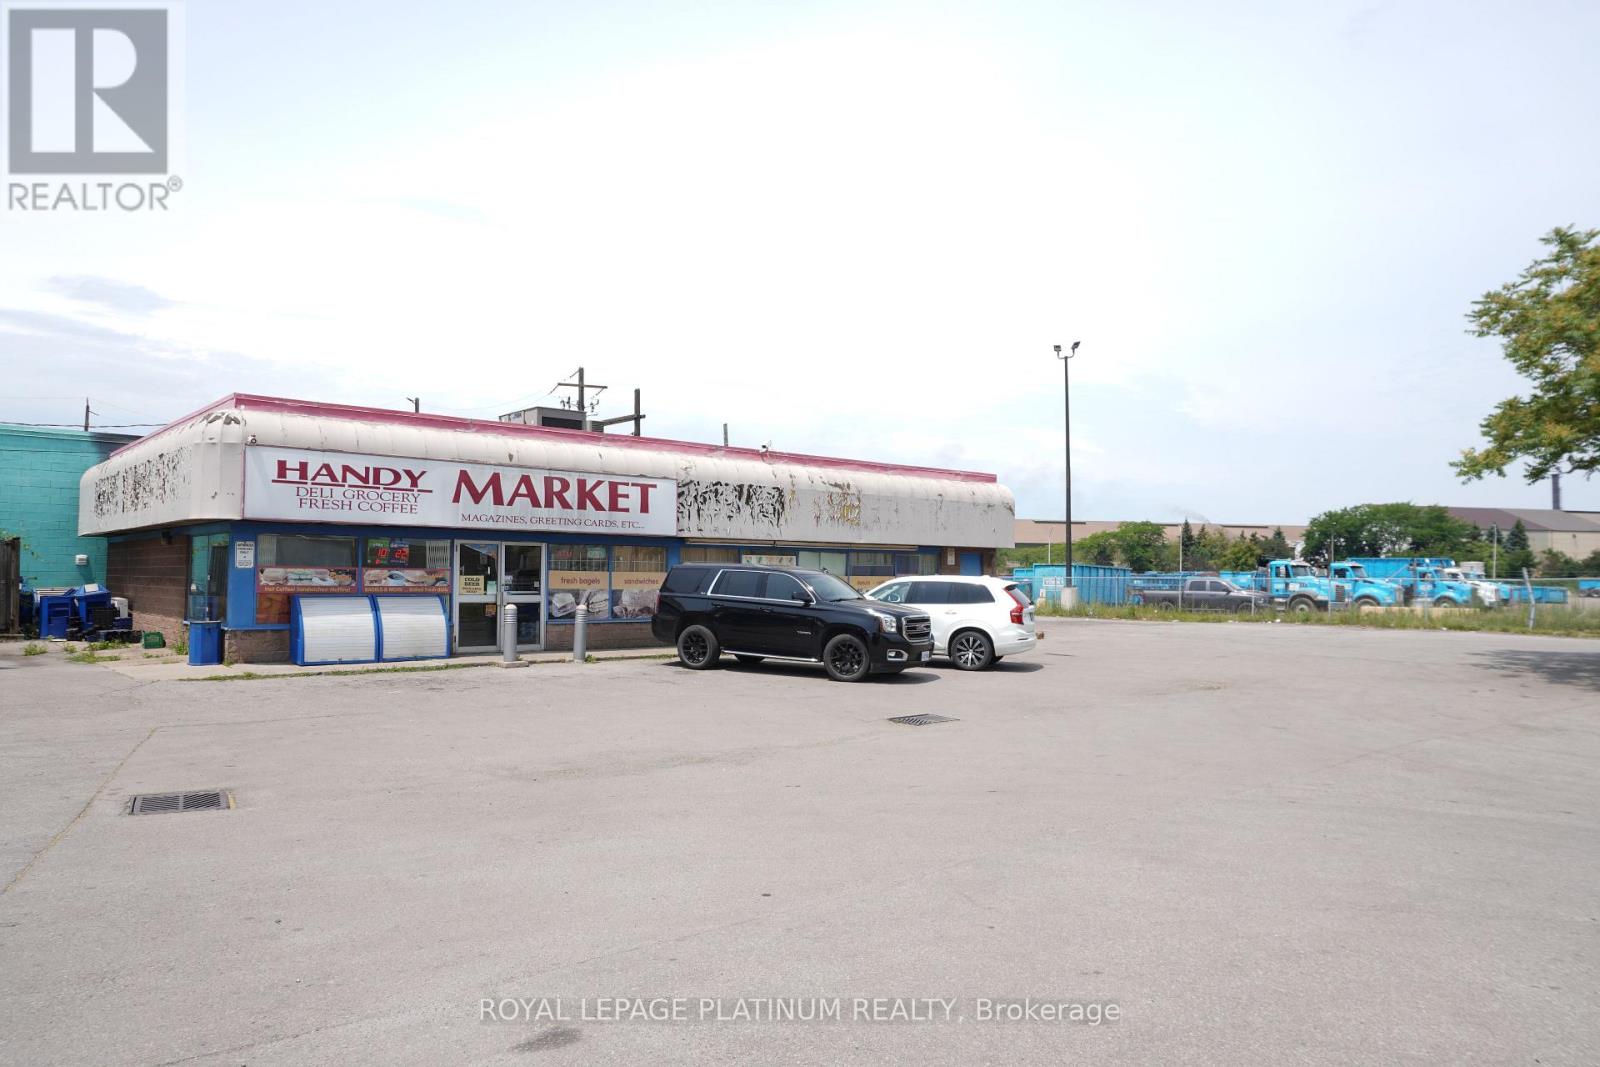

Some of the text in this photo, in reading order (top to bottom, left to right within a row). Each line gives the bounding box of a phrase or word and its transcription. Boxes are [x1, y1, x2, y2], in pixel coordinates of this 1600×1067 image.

[276, 459, 428, 489] HANDY
[296, 486, 421, 504] DELI GROCERY
[451, 469, 658, 514] MARKET
[299, 497, 418, 515] FRESH COFFEE
[461, 513, 528, 525] MAGAZINES,
[530, 516, 582, 527] GREETING
[584, 518, 619, 529] CARDS,
[560, 576, 600, 586] fresh bagels
